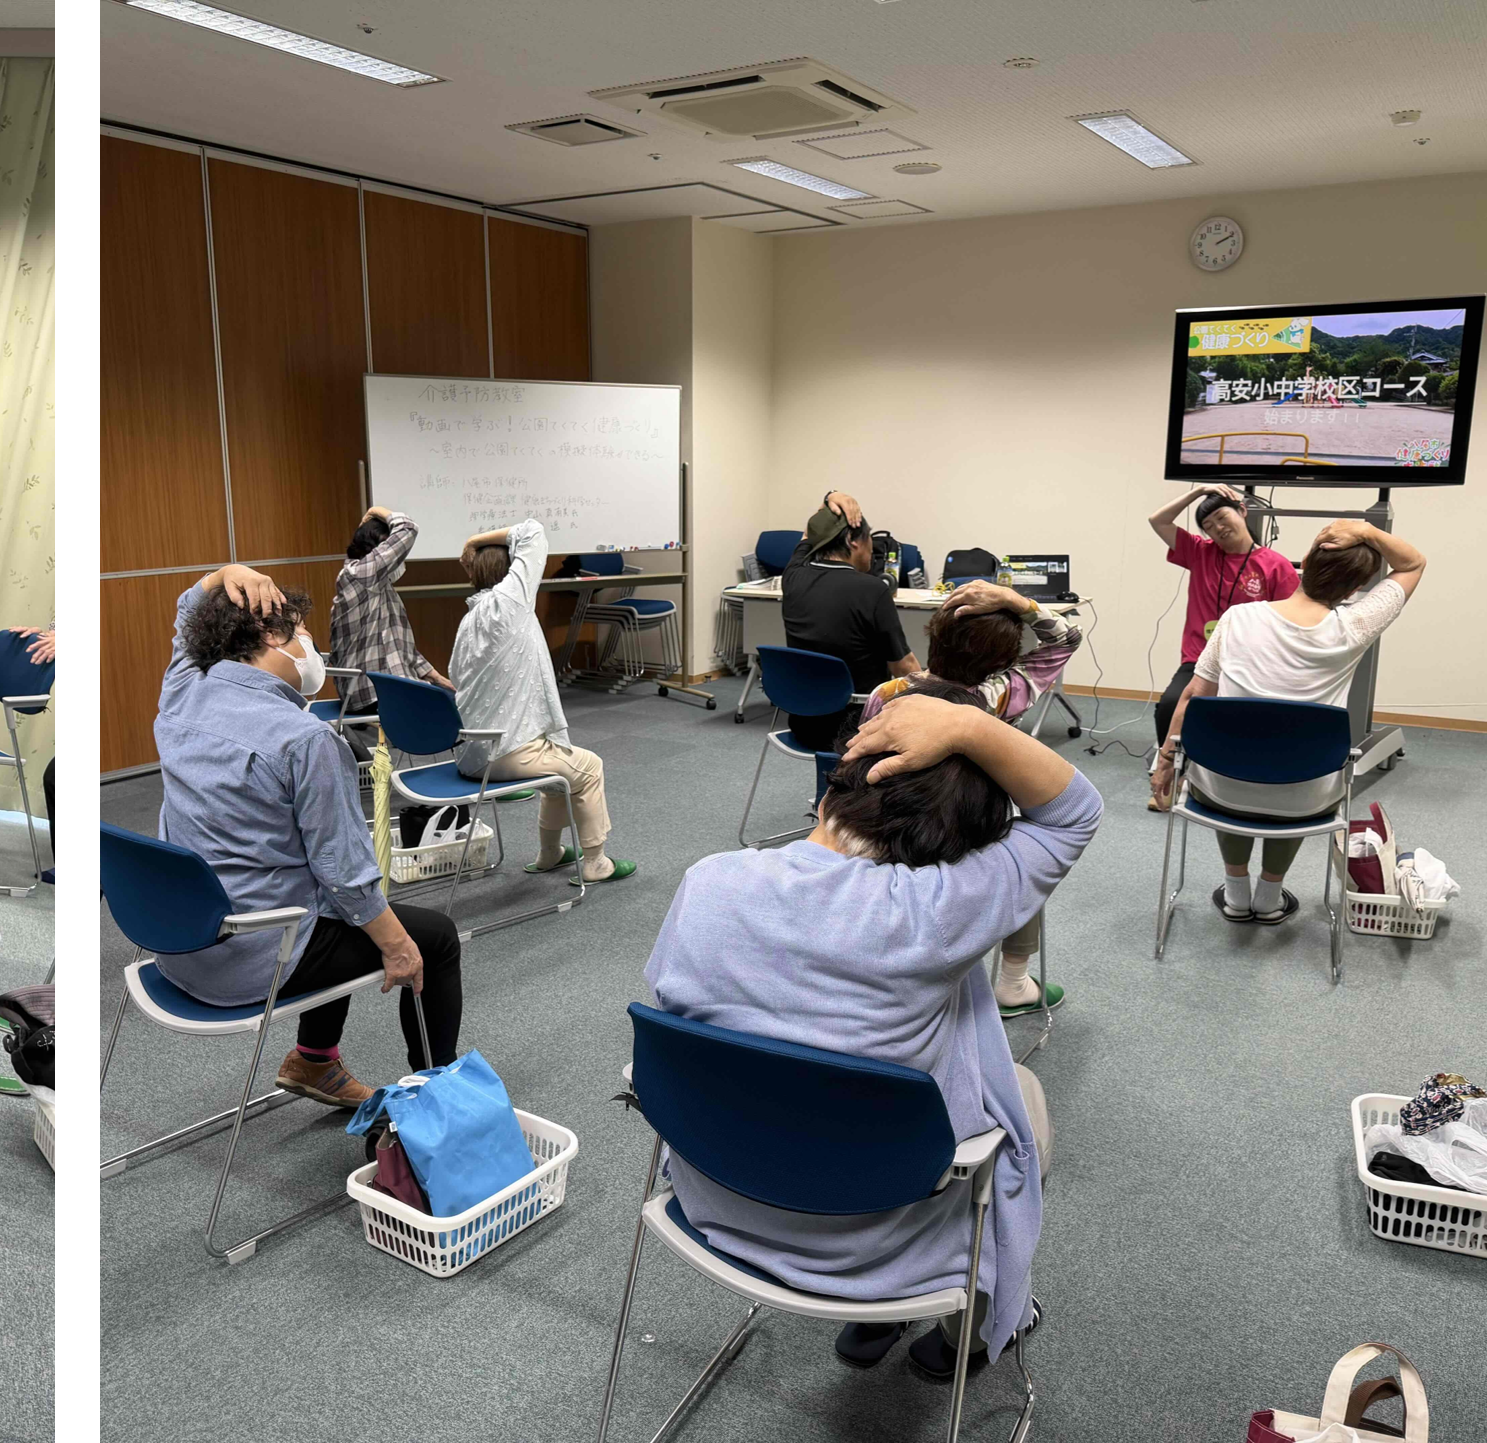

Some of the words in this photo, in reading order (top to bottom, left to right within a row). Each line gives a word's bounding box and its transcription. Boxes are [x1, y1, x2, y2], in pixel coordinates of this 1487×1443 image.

[1202, 332, 1269, 350] 健康づくり
[418, 384, 525, 403] 介護予防教室
[1212, 375, 1428, 401] 高安小中学校区コース
